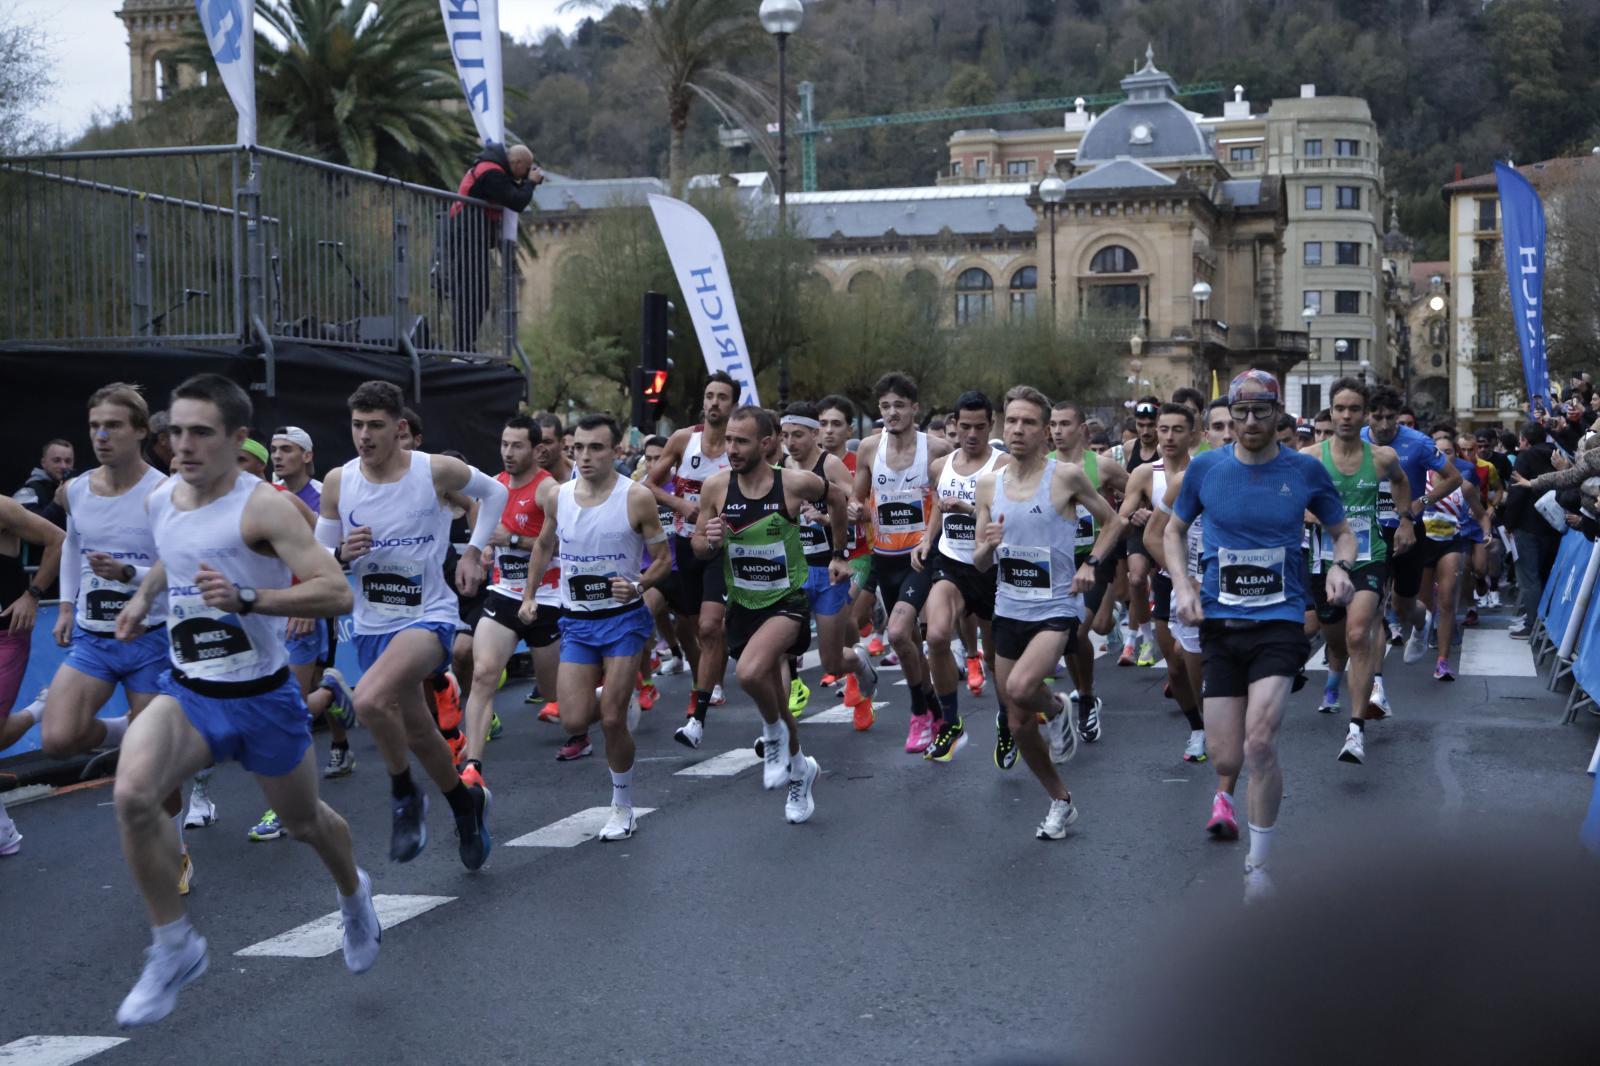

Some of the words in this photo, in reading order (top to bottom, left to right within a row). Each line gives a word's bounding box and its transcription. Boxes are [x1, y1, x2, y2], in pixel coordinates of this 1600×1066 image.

[890, 509, 913, 517] MAEL
[560, 553, 627, 562] DONOSTIA
[1241, 553, 1275, 563] ZURICH
[742, 564, 781, 573] ANDONI
[1012, 568, 1038, 577] JUSSI
[749, 574, 770, 582] 10001
[1235, 574, 1275, 585] ALBAN
[370, 582, 423, 595] HARKAITZ
[584, 583, 607, 592] OIER
[1239, 587, 1266, 596] 10087
[382, 594, 407, 605] 10098
[193, 629, 233, 645] MIKEL
